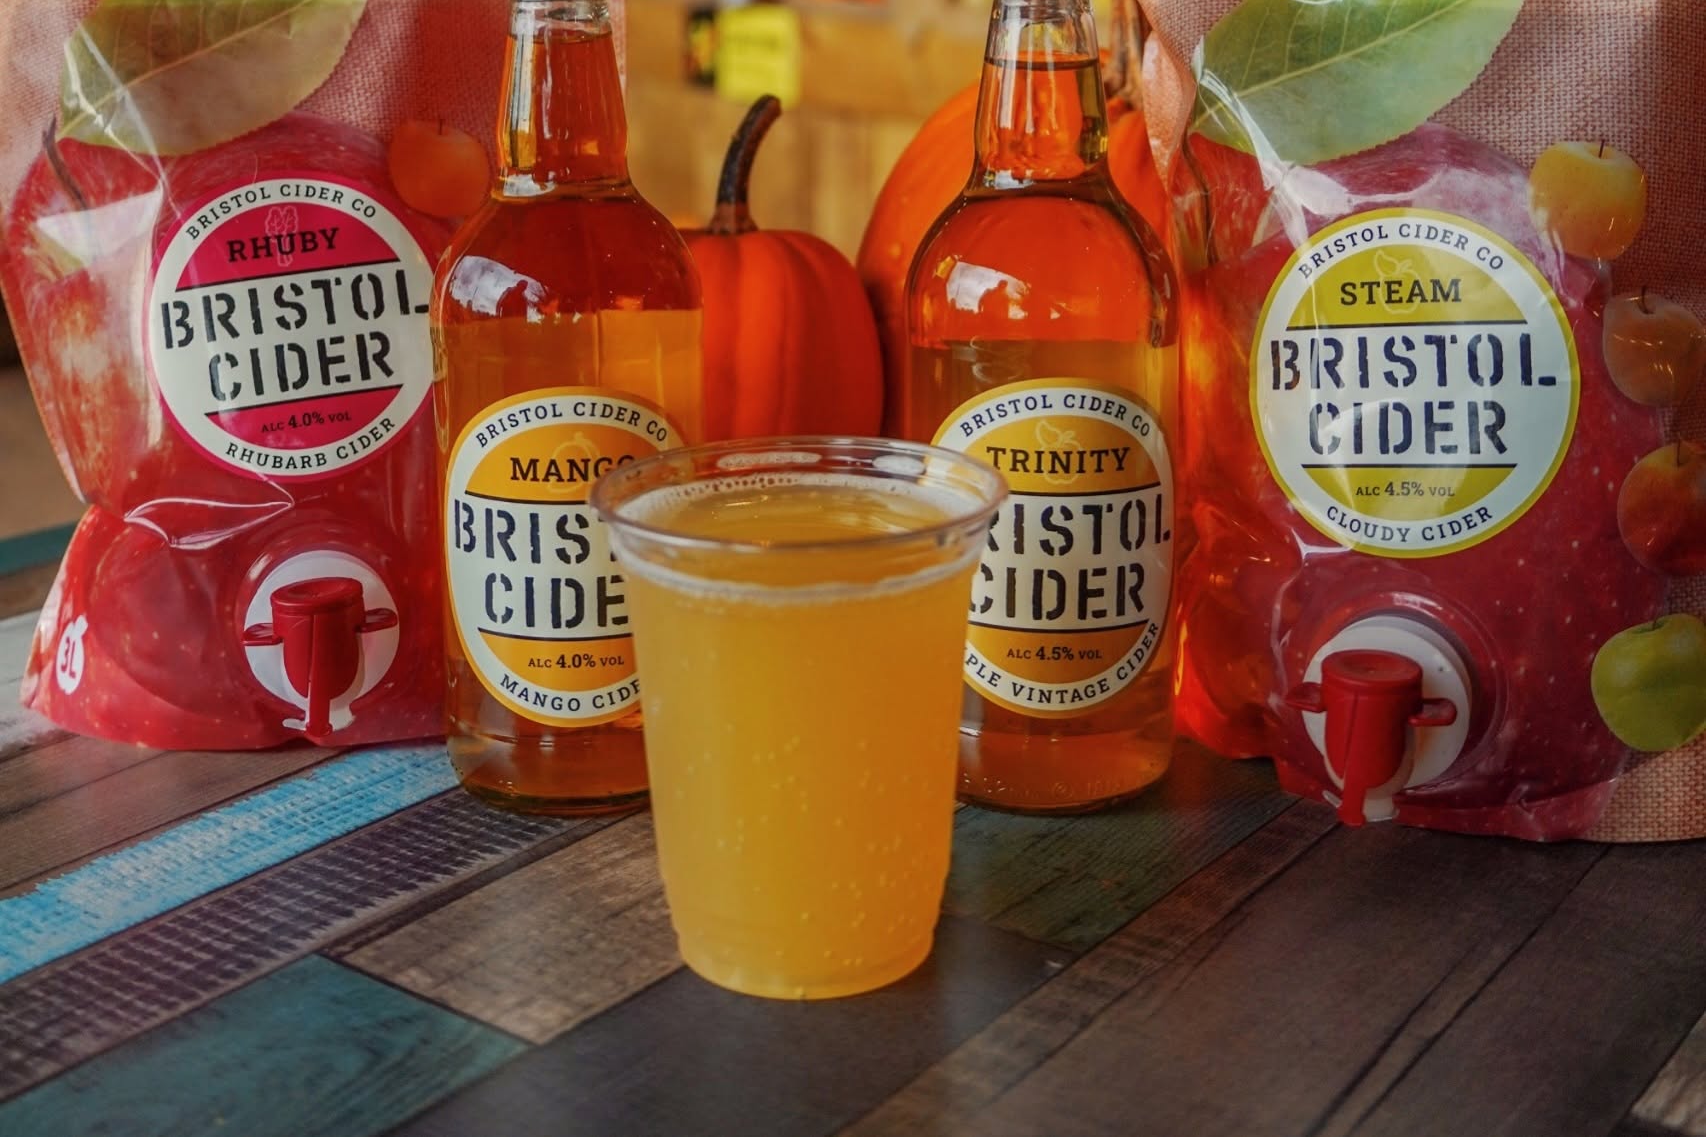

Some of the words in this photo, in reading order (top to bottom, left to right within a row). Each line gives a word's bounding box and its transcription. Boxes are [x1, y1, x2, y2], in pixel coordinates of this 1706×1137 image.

[185, 187, 271, 240] BRISTOL
[280, 184, 344, 204] CIDER
[351, 198, 376, 219] CO
[227, 228, 340, 262] RHUBY
[1298, 225, 1389, 280] BRISTOL
[1398, 223, 1469, 252] CIDER
[1476, 246, 1504, 271] CO
[161, 270, 430, 350] BRISTOL
[1340, 278, 1462, 306] STEAM
[208, 331, 394, 402] CIDER
[1270, 333, 1557, 391] BRISTOL
[261, 422, 284, 434] ALC
[287, 411, 325, 429] 4.0%
[328, 412, 352, 423] VOL
[475, 403, 563, 448] BRISTOL
[573, 402, 640, 426] CIDER
[646, 420, 668, 442] CO
[960, 394, 1052, 437] BRISTOL
[1064, 394, 1127, 421] CIDER
[1131, 414, 1150, 437] CO
[1309, 399, 1509, 455] CIDER
[226, 442, 327, 470] RHUBARB
[336, 418, 396, 459] CIDER
[986, 446, 1131, 474] TRINITY
[1355, 485, 1381, 497] ALC
[1384, 481, 1425, 498] 4.5%
[1429, 486, 1455, 497] VOL
[454, 499, 617, 564] BRIS
[1326, 505, 1411, 543] CLOUDY
[1421, 505, 1494, 542] CIDER
[485, 572, 628, 629] CIDE
[970, 562, 1145, 620] CIDER
[528, 658, 552, 668] ALC
[555, 653, 597, 669] 4.0%
[599, 656, 624, 667] VOL
[1007, 648, 1031, 659] ALC
[1035, 646, 1074, 661] 4.5%
[1078, 649, 1102, 659] VOL
[1011, 678, 1111, 704] VINTAGE
[1116, 622, 1159, 680] CIDER
[500, 674, 581, 711] MANGO
[592, 678, 641, 709] CIDE
